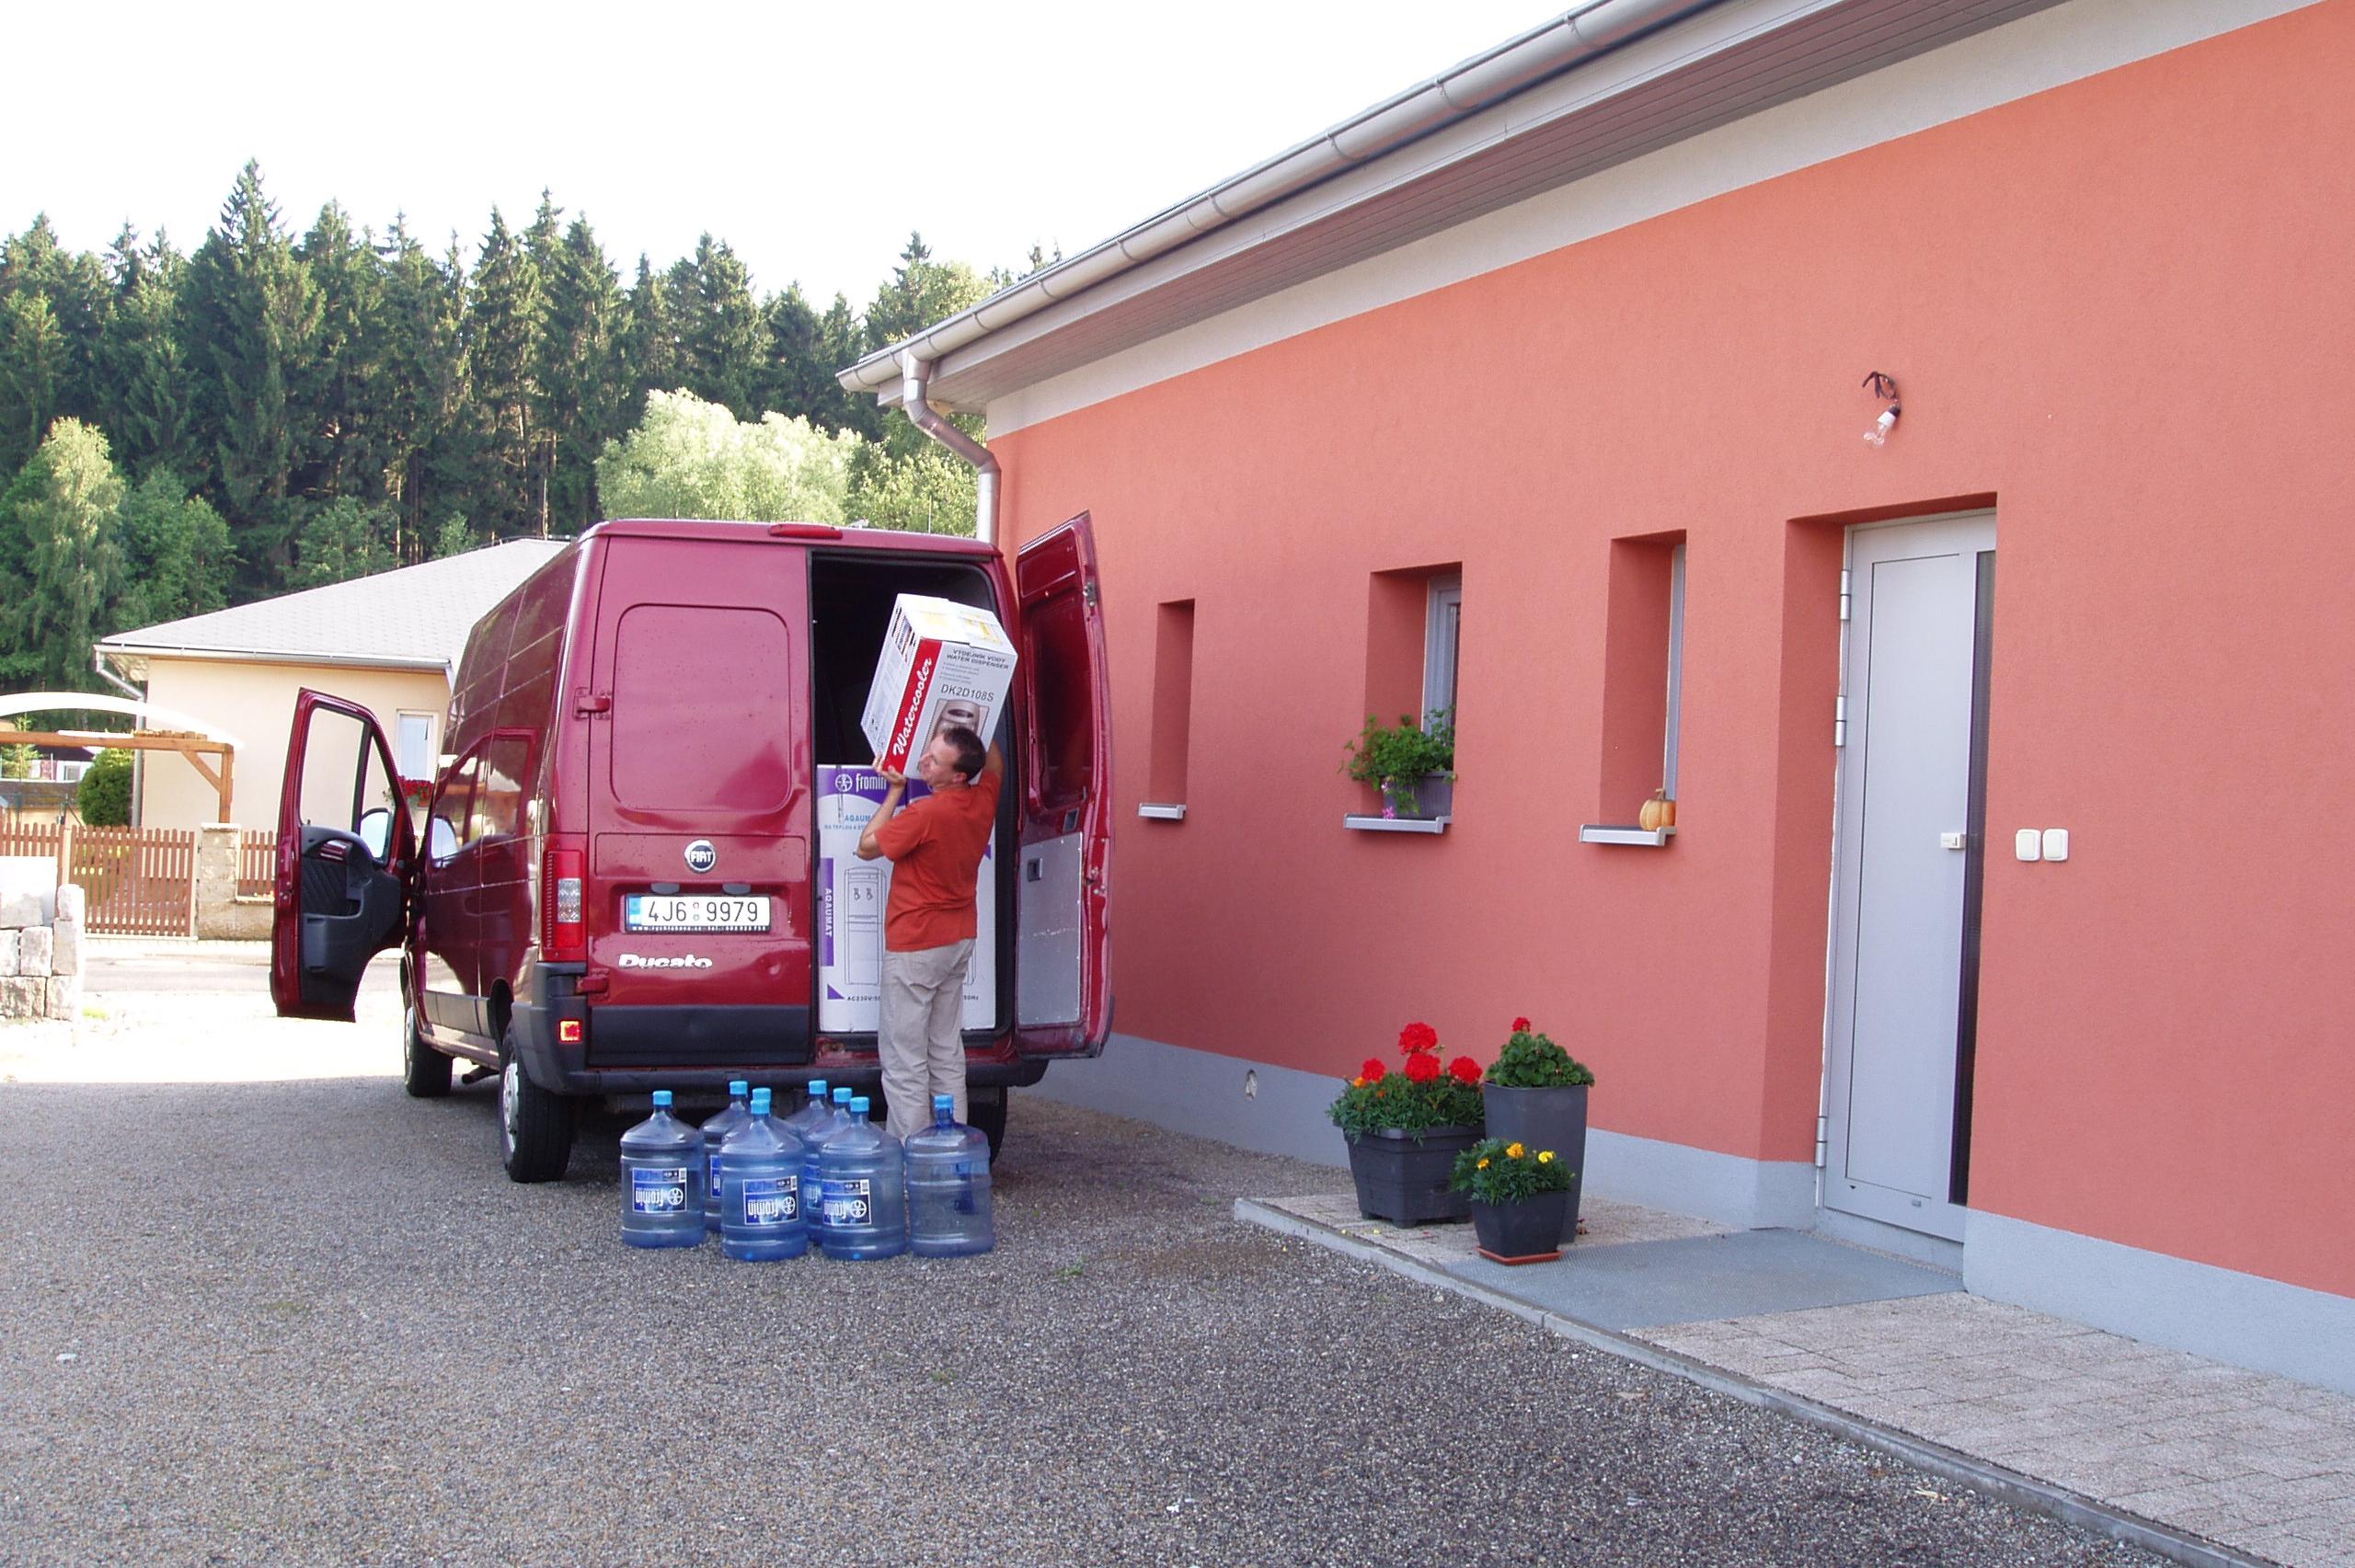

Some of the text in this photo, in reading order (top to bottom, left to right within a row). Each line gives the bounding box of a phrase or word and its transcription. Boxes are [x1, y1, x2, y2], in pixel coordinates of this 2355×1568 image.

[947, 654, 971, 662] WATER
[971, 658, 1009, 670] DISPENSER
[940, 683, 994, 702] DK2D108S
[892, 658, 932, 756] Watercooler
[690, 850, 712, 863] FIAT
[648, 901, 759, 921] 4J6 9979
[618, 954, 713, 968] Ducato
[747, 1197, 779, 1218] fromin
